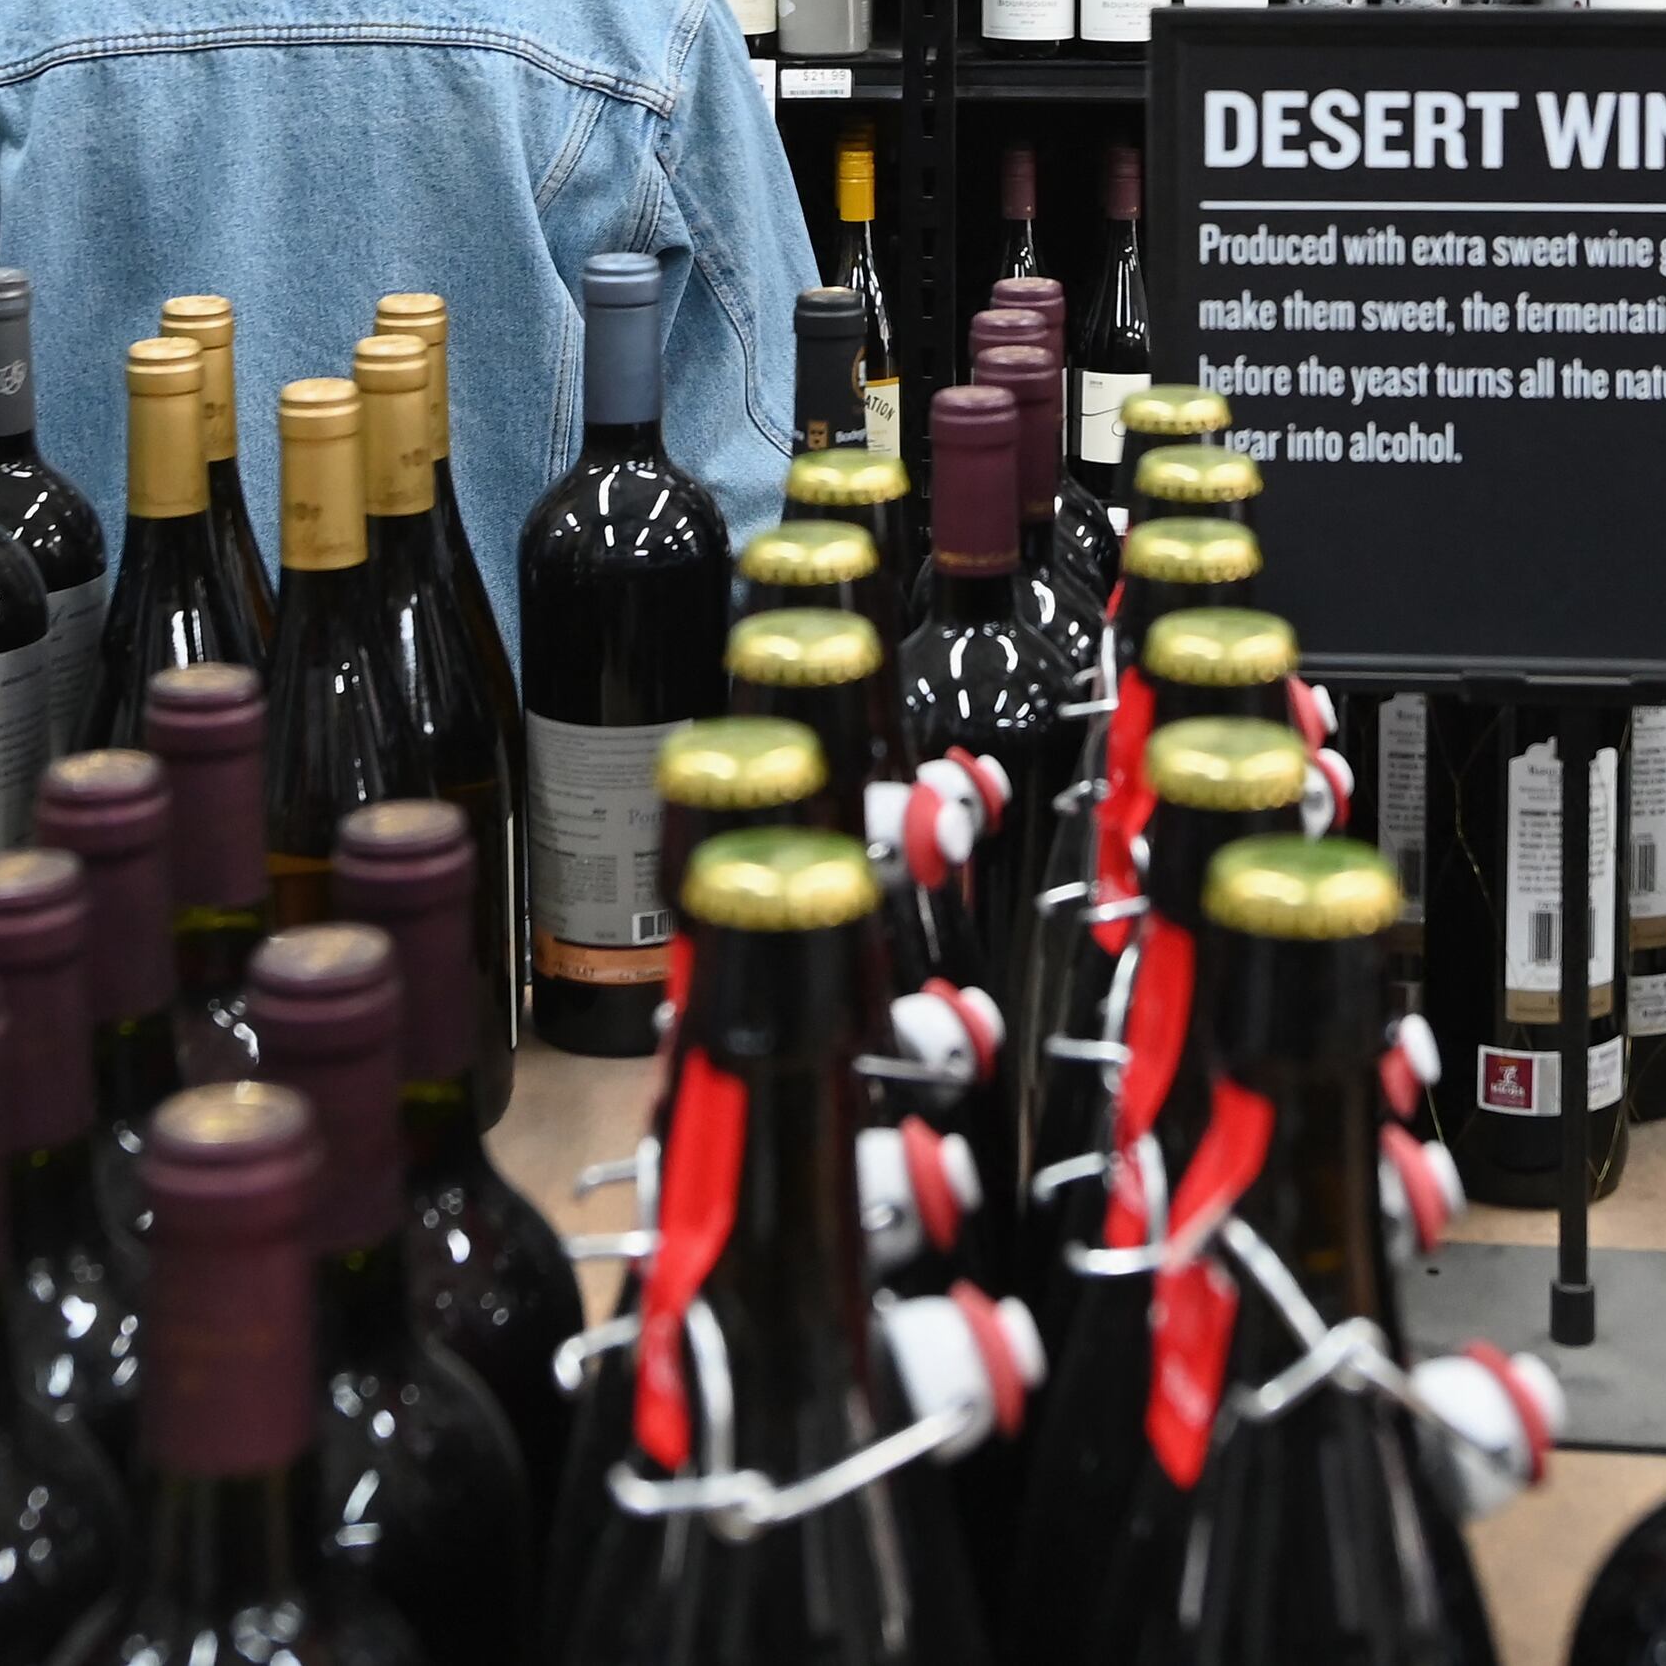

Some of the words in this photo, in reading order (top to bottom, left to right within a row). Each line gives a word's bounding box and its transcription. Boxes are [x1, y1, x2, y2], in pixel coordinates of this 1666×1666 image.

[803, 71, 847, 82] $21.99
[1202, 89, 1519, 170] DESERT
[1198, 223, 1336, 267] Produced
[1343, 228, 1405, 267] with
[1412, 228, 1486, 267] extra
[1492, 231, 1578, 268] sweet
[1585, 227, 1652, 269] wine
[1199, 291, 1277, 332] make
[1283, 291, 1355, 332] them
[1362, 294, 1454, 336] sweet,
[1462, 292, 1509, 333] the
[1199, 355, 1292, 396] before
[1298, 355, 1343, 398] the
[1350, 362, 1429, 405] yeast
[1436, 361, 1513, 399] turns
[1520, 359, 1555, 399] all
[1561, 359, 1609, 399] the
[1287, 422, 1343, 463] into
[1349, 422, 1463, 465] alcohol.
